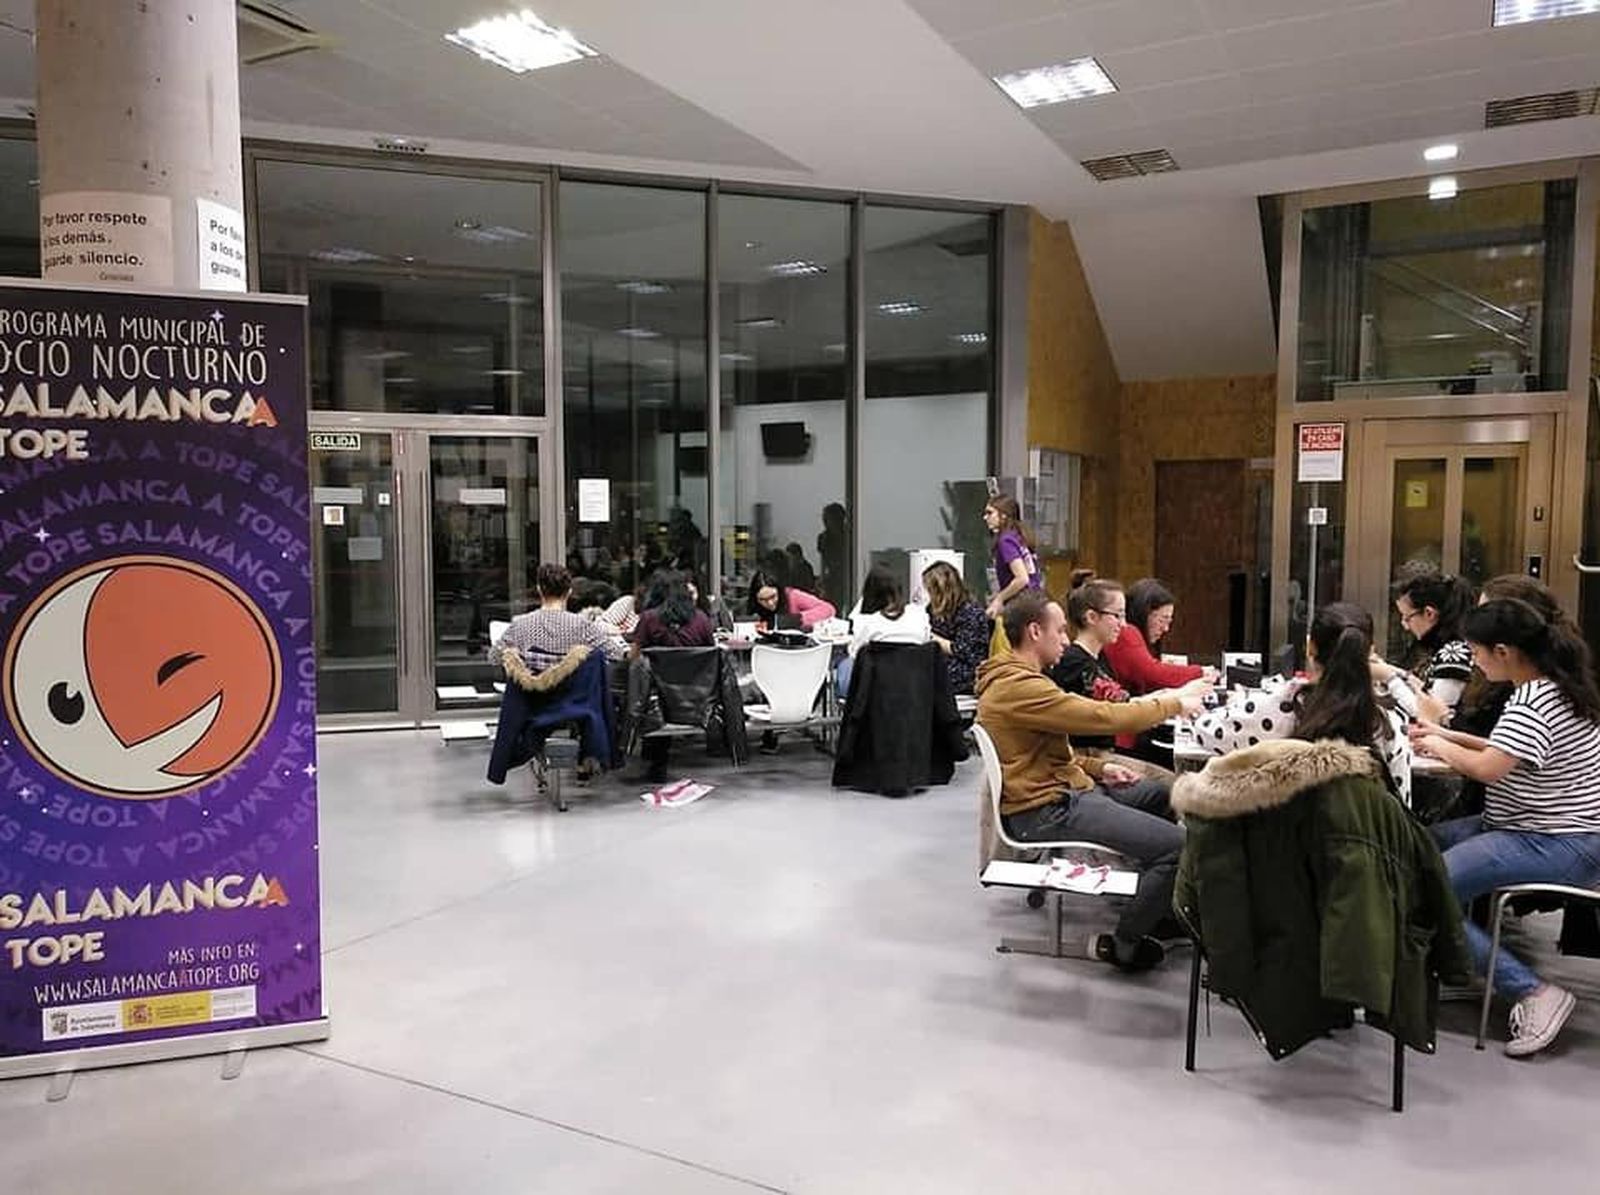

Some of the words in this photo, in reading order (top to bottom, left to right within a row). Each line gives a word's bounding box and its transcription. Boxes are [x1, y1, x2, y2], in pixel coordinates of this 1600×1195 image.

[88, 212, 147, 227] respete
[210, 219, 228, 236] Por
[78, 252, 143, 266] silencio.
[210, 242, 217, 252] a
[219, 242, 234, 258] los
[120, 316, 230, 346] MUNICIPAL
[242, 322, 266, 348] DE
[93, 344, 267, 385] NOCTURNO
[314, 435, 358, 447] SALIDA
[174, 441, 258, 484] TOPE
[0, 479, 192, 546] ALAMANCA
[202, 492, 225, 516] A
[5, 530, 93, 586] TOPE
[96, 519, 293, 611] SALAMANCA
[283, 616, 310, 637] A
[46, 793, 139, 828] TOPE
[21, 831, 108, 868] TOPE
[5, 931, 105, 970] TOPE
[201, 944, 232, 962] INFO
